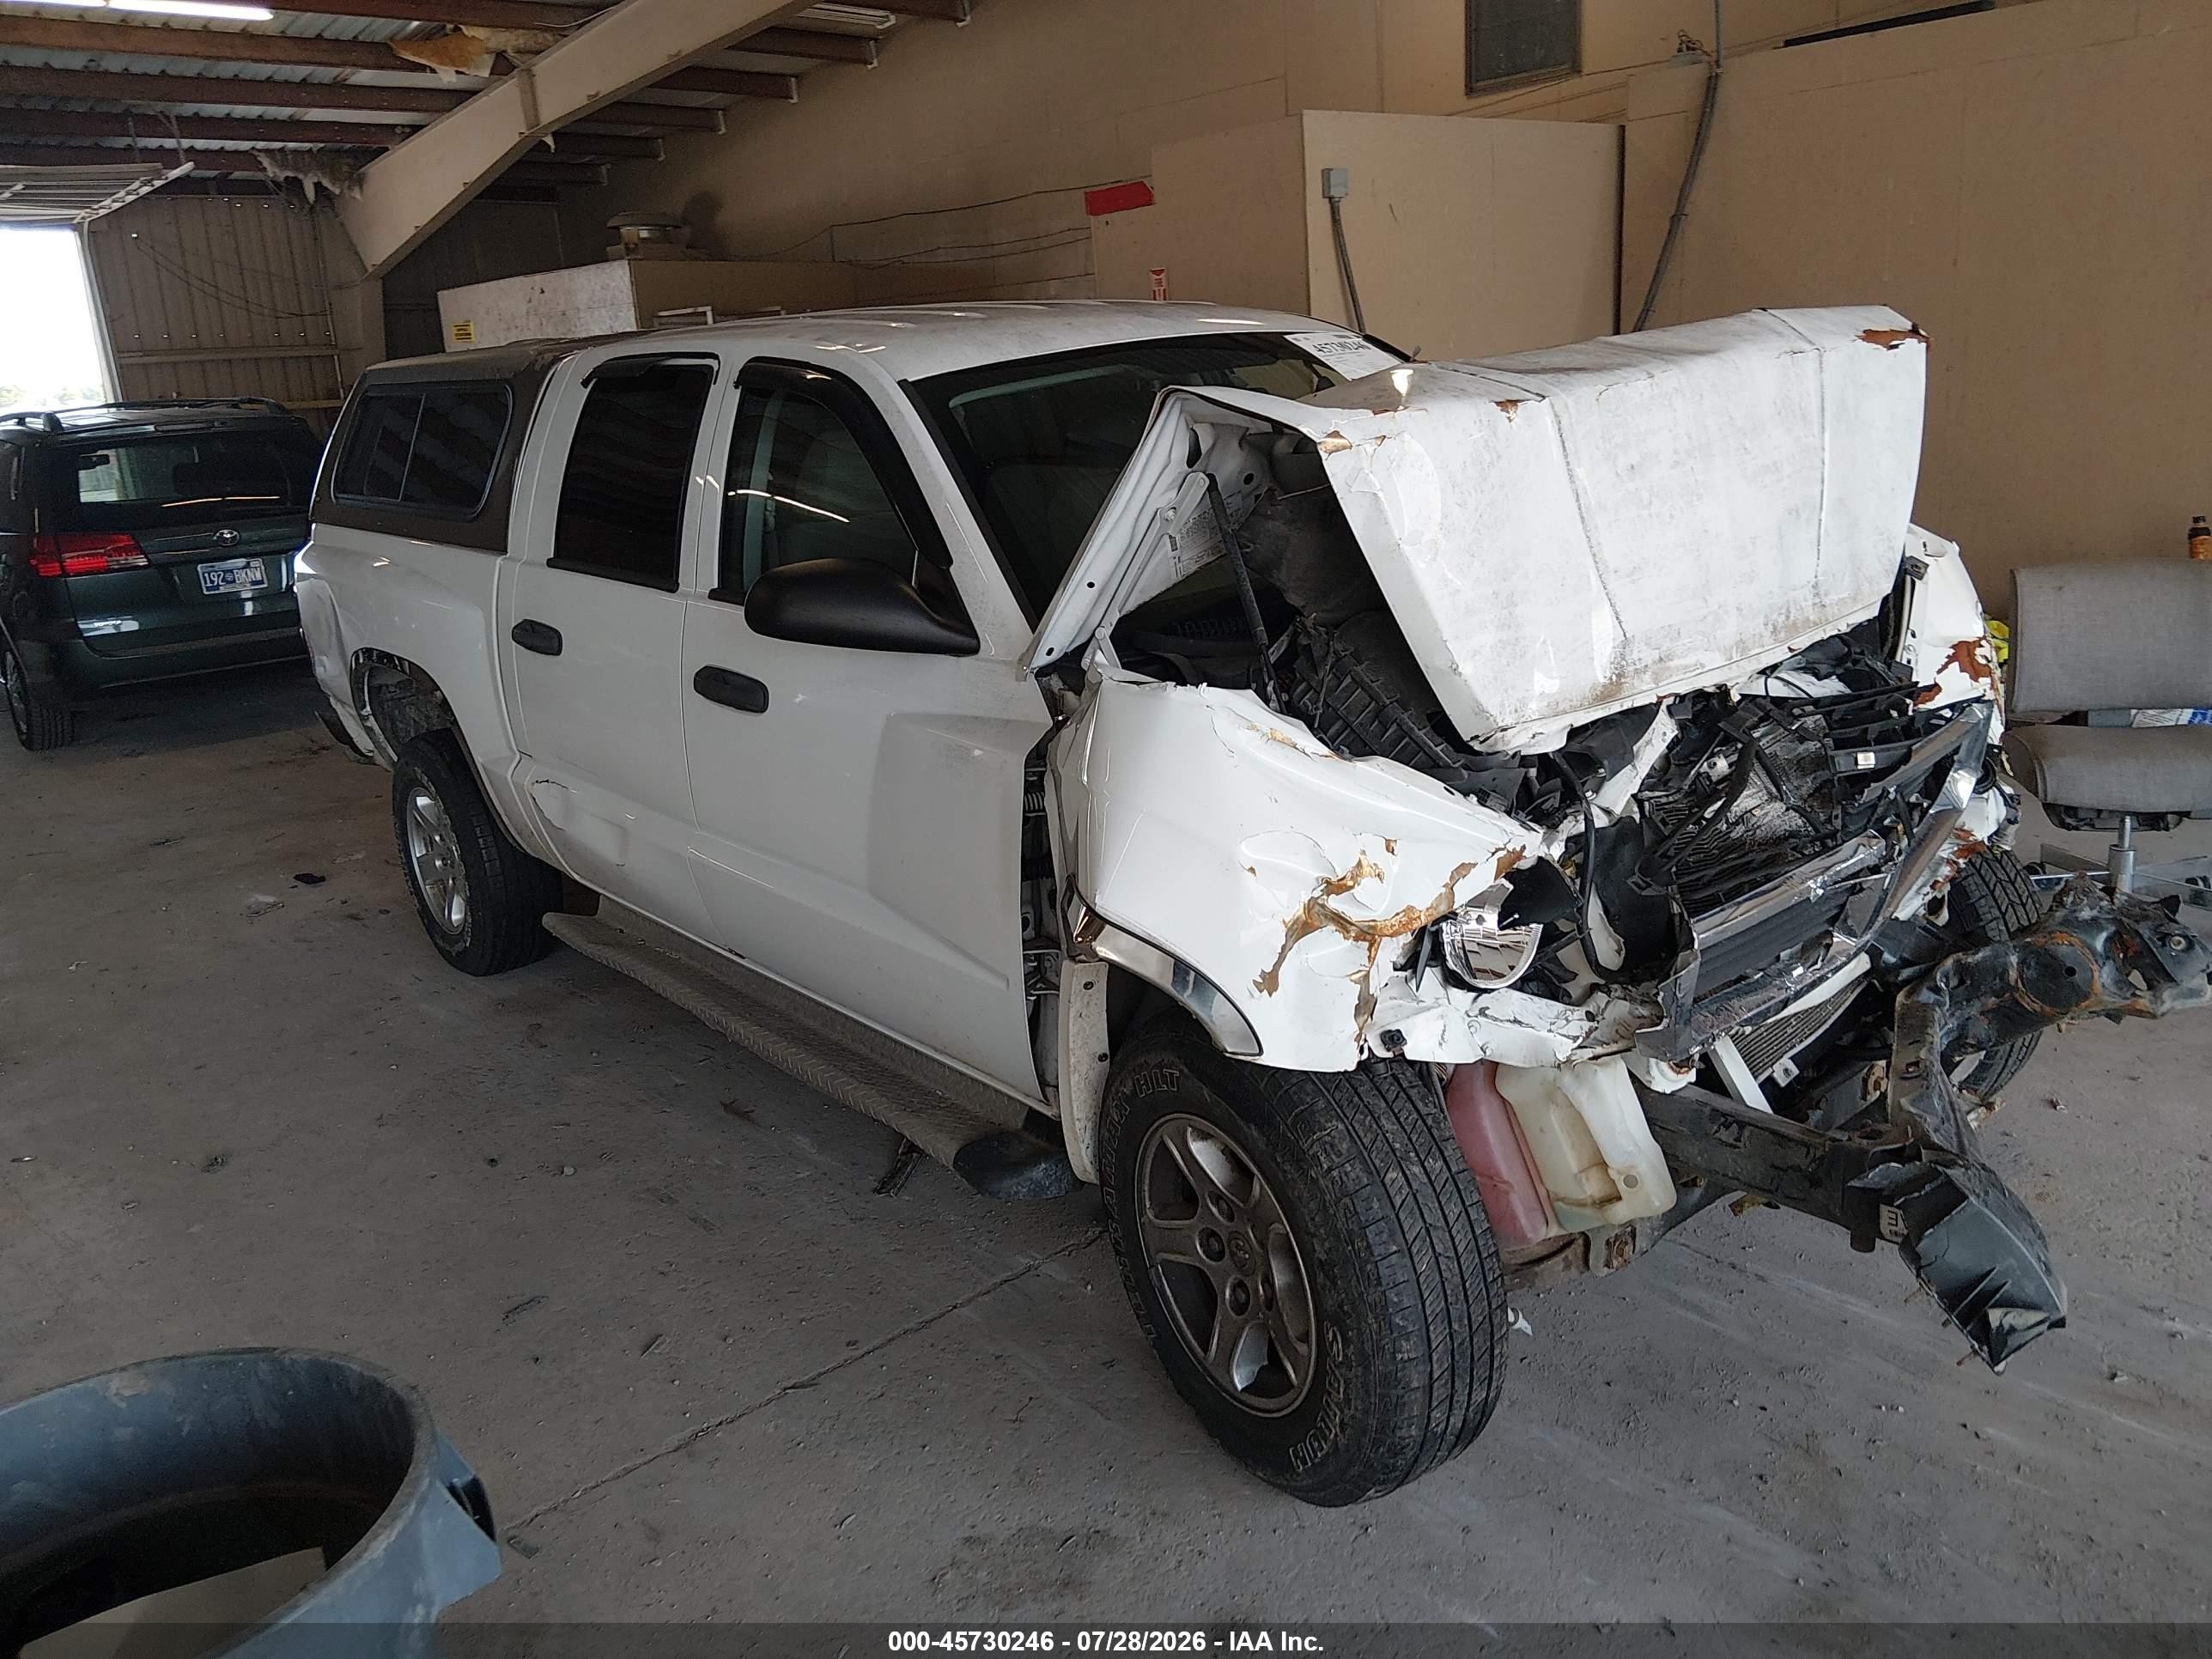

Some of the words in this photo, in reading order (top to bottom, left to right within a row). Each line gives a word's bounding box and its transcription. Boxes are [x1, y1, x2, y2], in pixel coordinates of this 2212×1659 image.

[1312, 341, 1371, 354] 45730246
[204, 570, 226, 586] 192
[1133, 1068, 1180, 1098] HLT
